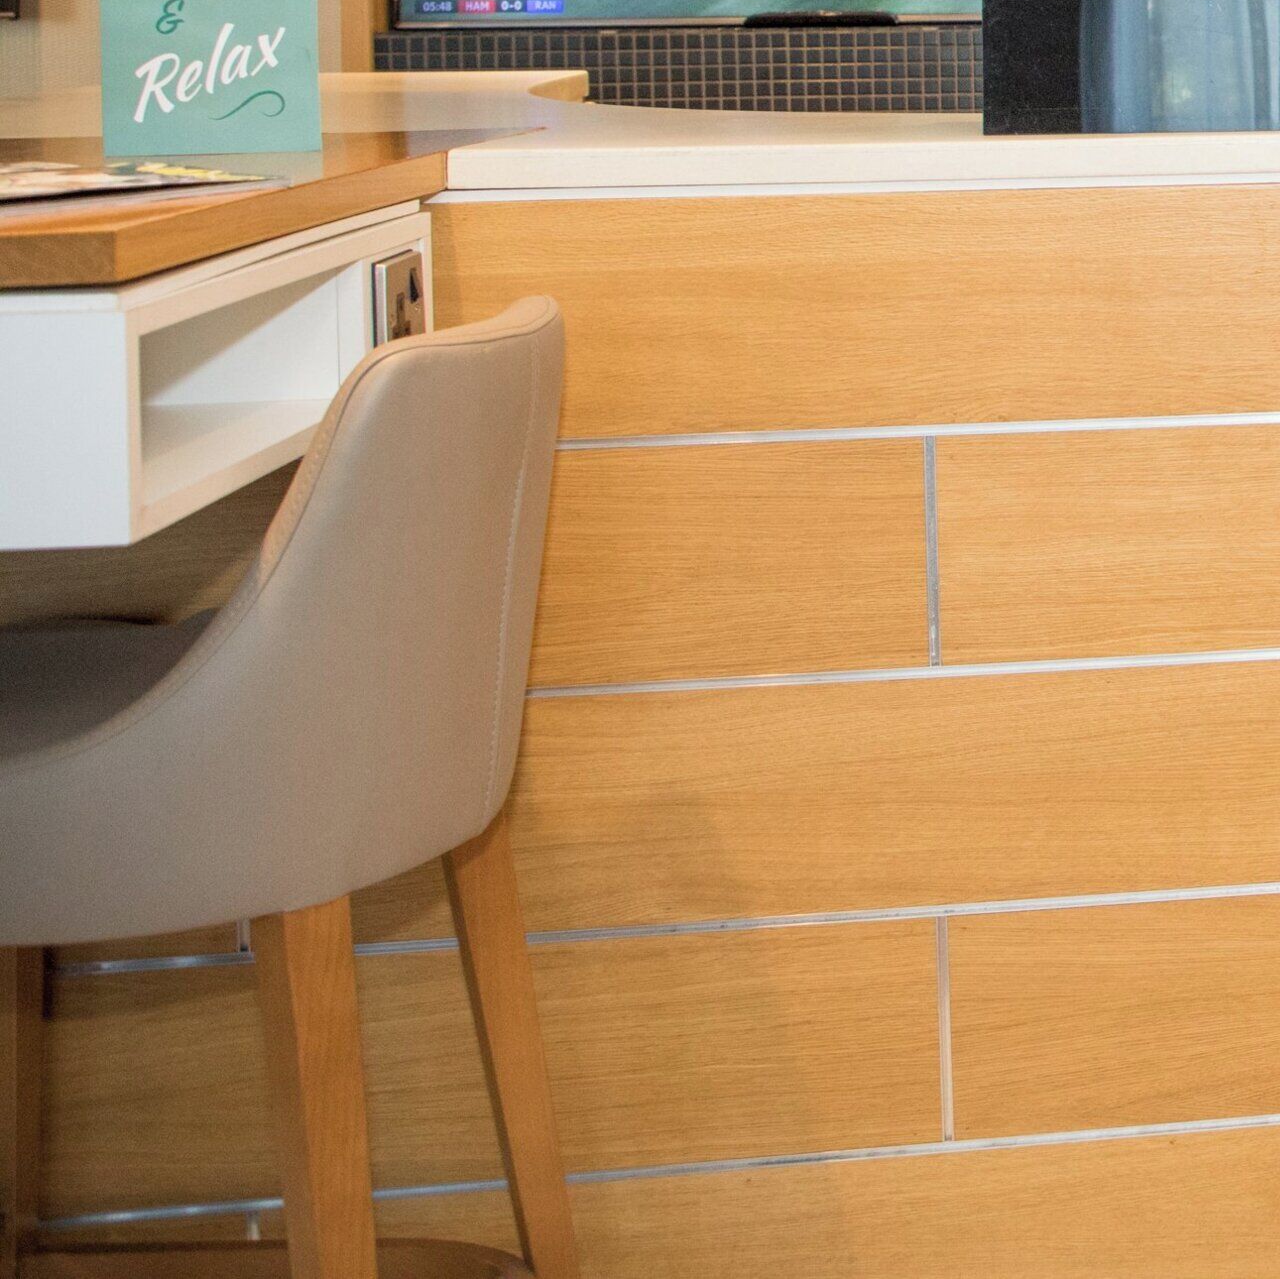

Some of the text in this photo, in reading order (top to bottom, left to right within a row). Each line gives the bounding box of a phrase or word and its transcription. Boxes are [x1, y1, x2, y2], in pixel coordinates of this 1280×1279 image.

[465, 0, 490, 11] HAM
[500, 0, 522, 10] 0-0
[534, 0, 557, 10] RAN
[133, 22, 286, 124] Relax
